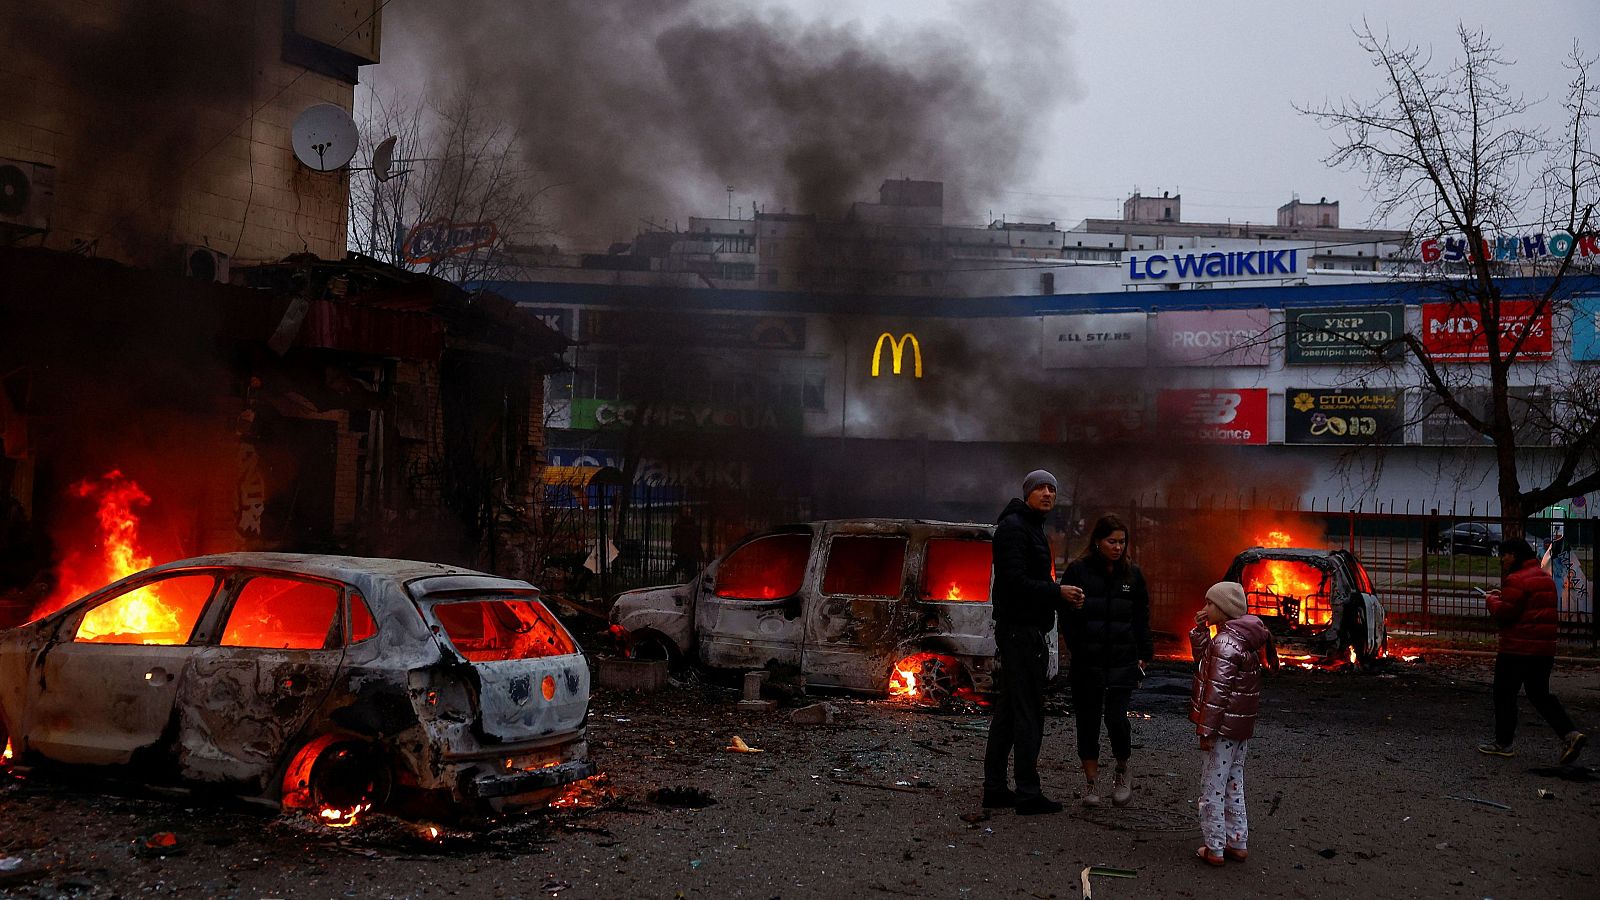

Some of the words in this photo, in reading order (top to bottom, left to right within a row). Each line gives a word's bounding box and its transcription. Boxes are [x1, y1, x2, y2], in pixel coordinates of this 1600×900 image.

[1130, 255, 1168, 280] LC
[1429, 317, 1479, 334] MD
[1058, 333, 1082, 342] ALL
[1086, 332, 1132, 342] STARS
